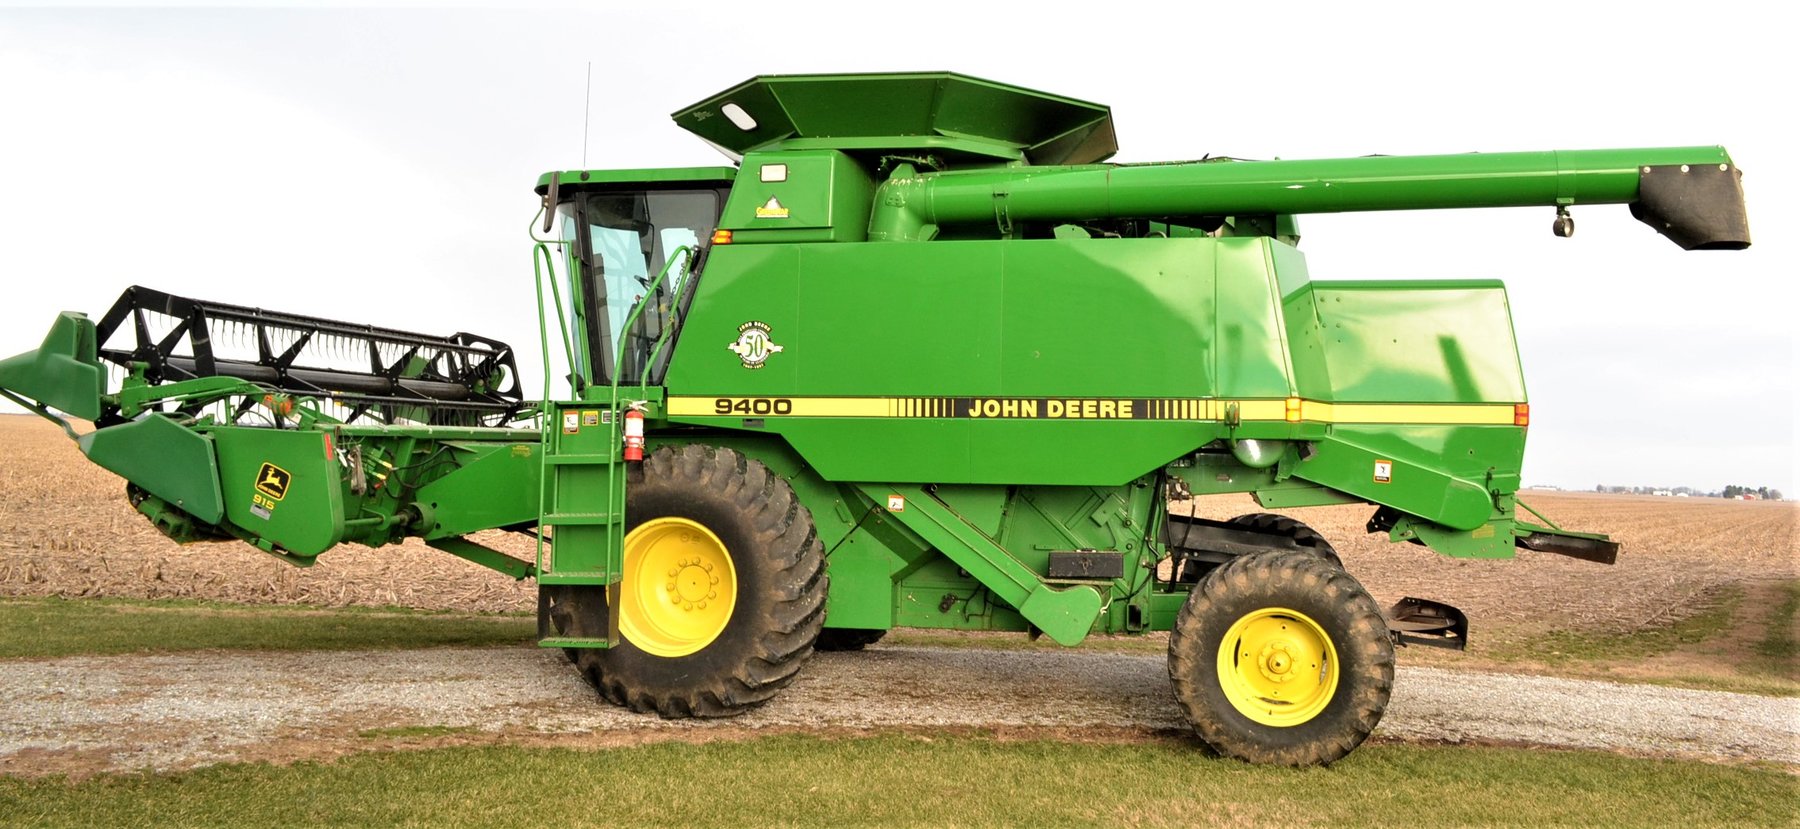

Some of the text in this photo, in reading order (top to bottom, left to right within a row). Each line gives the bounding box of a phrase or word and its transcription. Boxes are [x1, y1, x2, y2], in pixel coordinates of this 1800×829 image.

[745, 334, 763, 358] 50
[715, 398, 792, 415] 9400
[968, 399, 1133, 418] JOHN DEERE
[253, 493, 275, 510] 915
